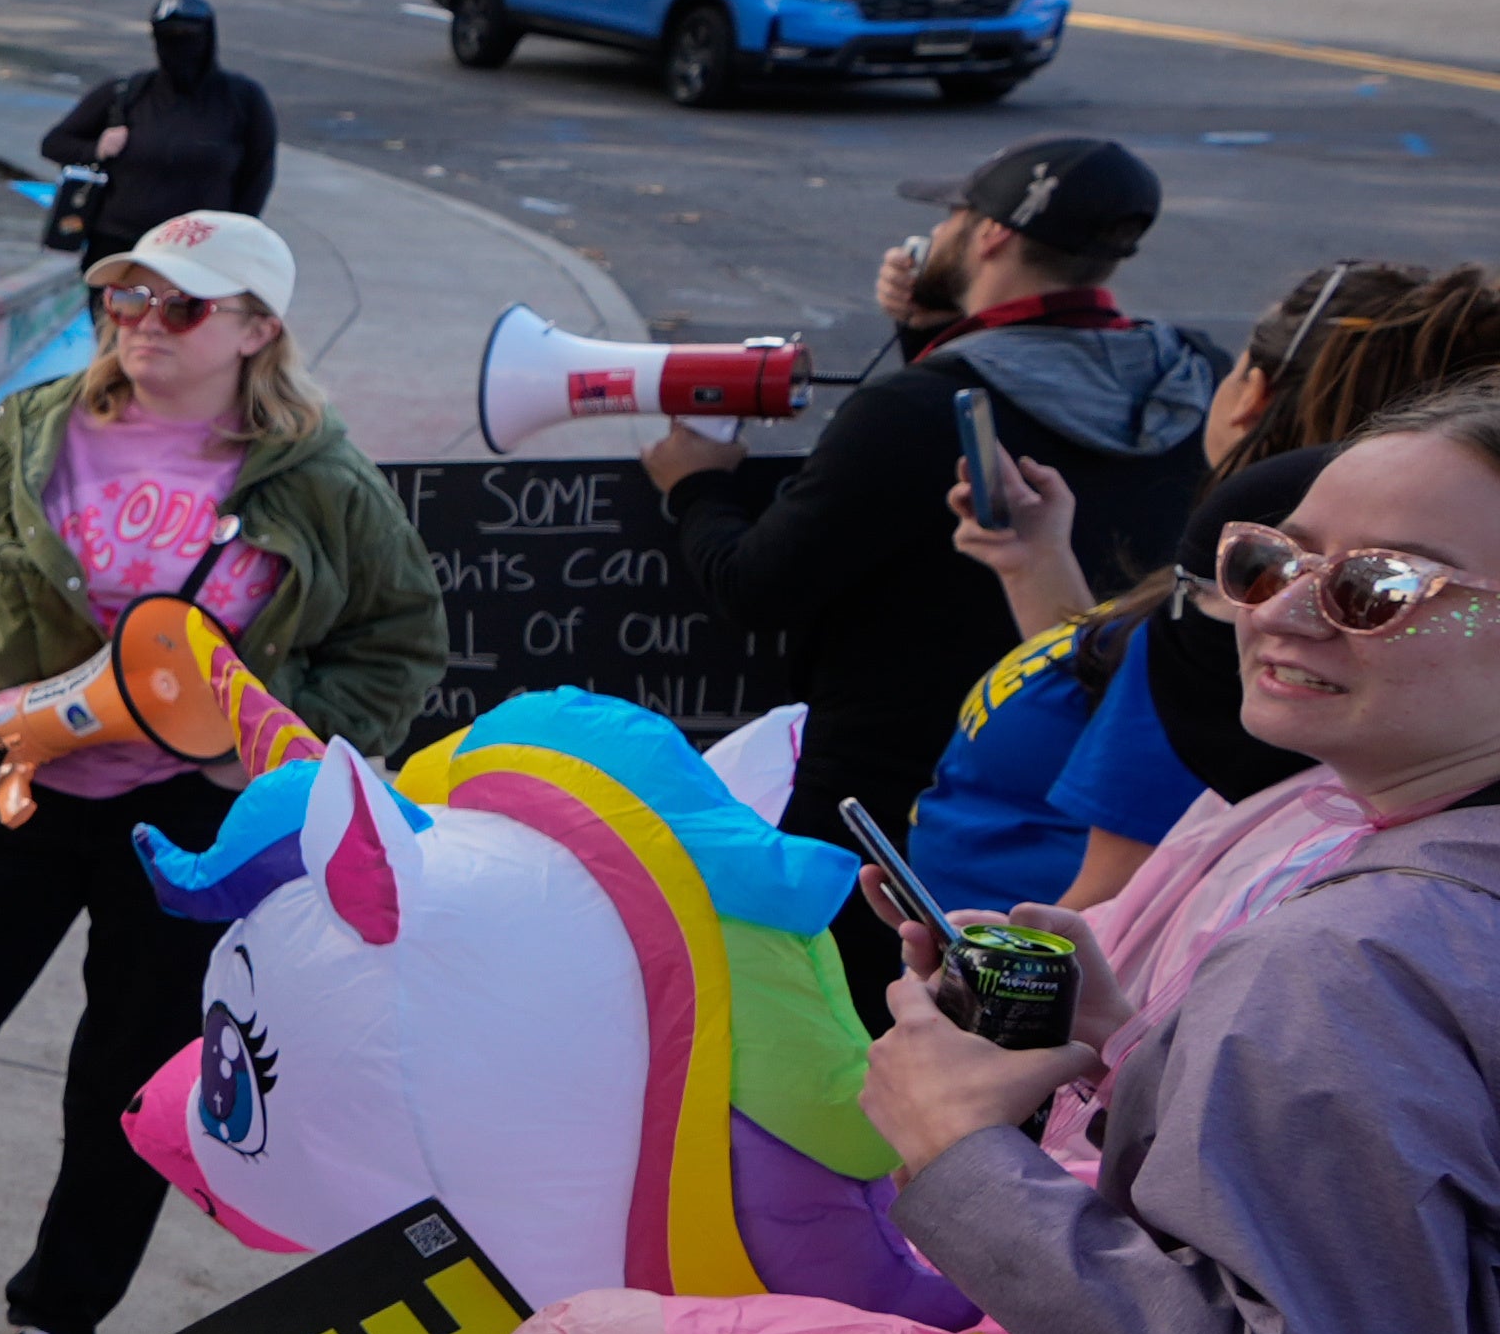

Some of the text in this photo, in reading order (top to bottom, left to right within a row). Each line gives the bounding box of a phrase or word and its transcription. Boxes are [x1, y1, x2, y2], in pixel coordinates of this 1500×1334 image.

[482, 467, 621, 529] SOME
[432, 548, 536, 592] ghts
[422, 685, 477, 718] an
